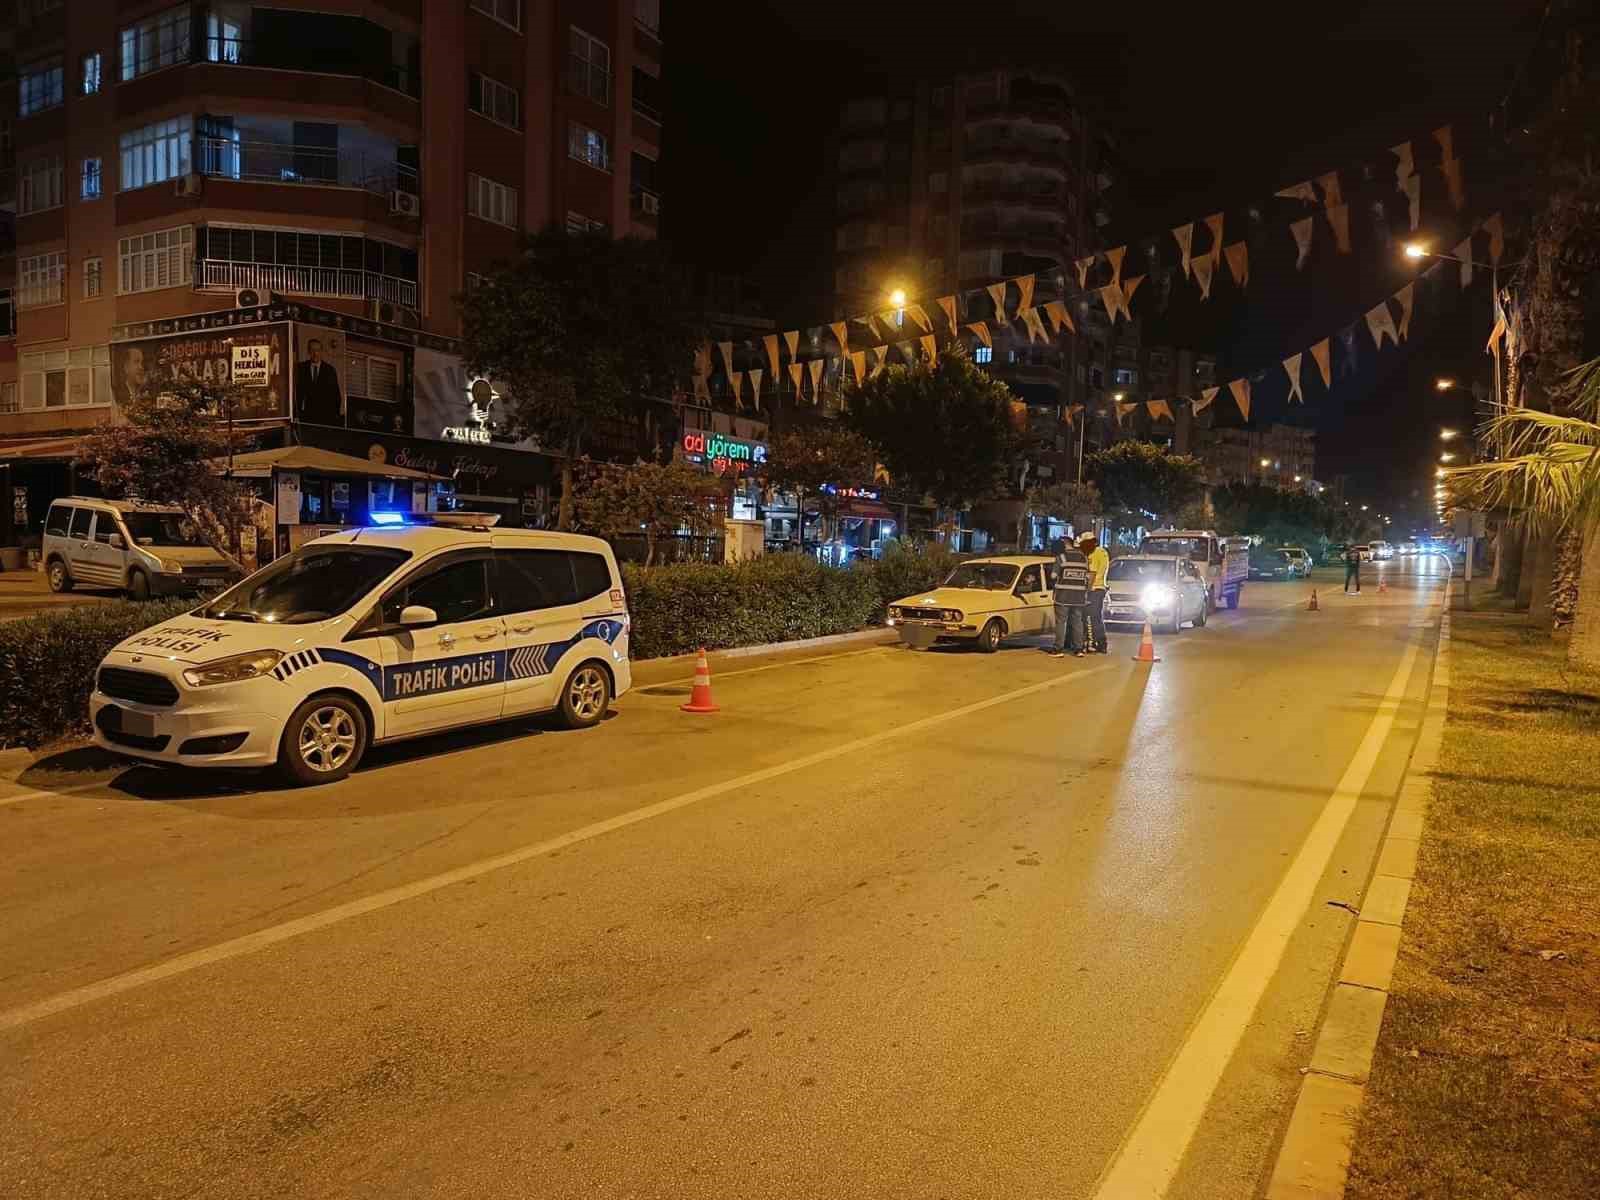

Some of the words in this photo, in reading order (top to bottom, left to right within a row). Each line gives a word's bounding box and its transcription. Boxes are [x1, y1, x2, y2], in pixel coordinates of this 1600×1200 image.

[240, 348, 260, 359] DİŞ
[706, 434, 749, 460] yörem
[152, 627, 233, 643] TRAFİK
[127, 636, 209, 654] POLİSİ
[392, 663, 448, 696] TRAFİK
[451, 655, 496, 687] POLİSİ
